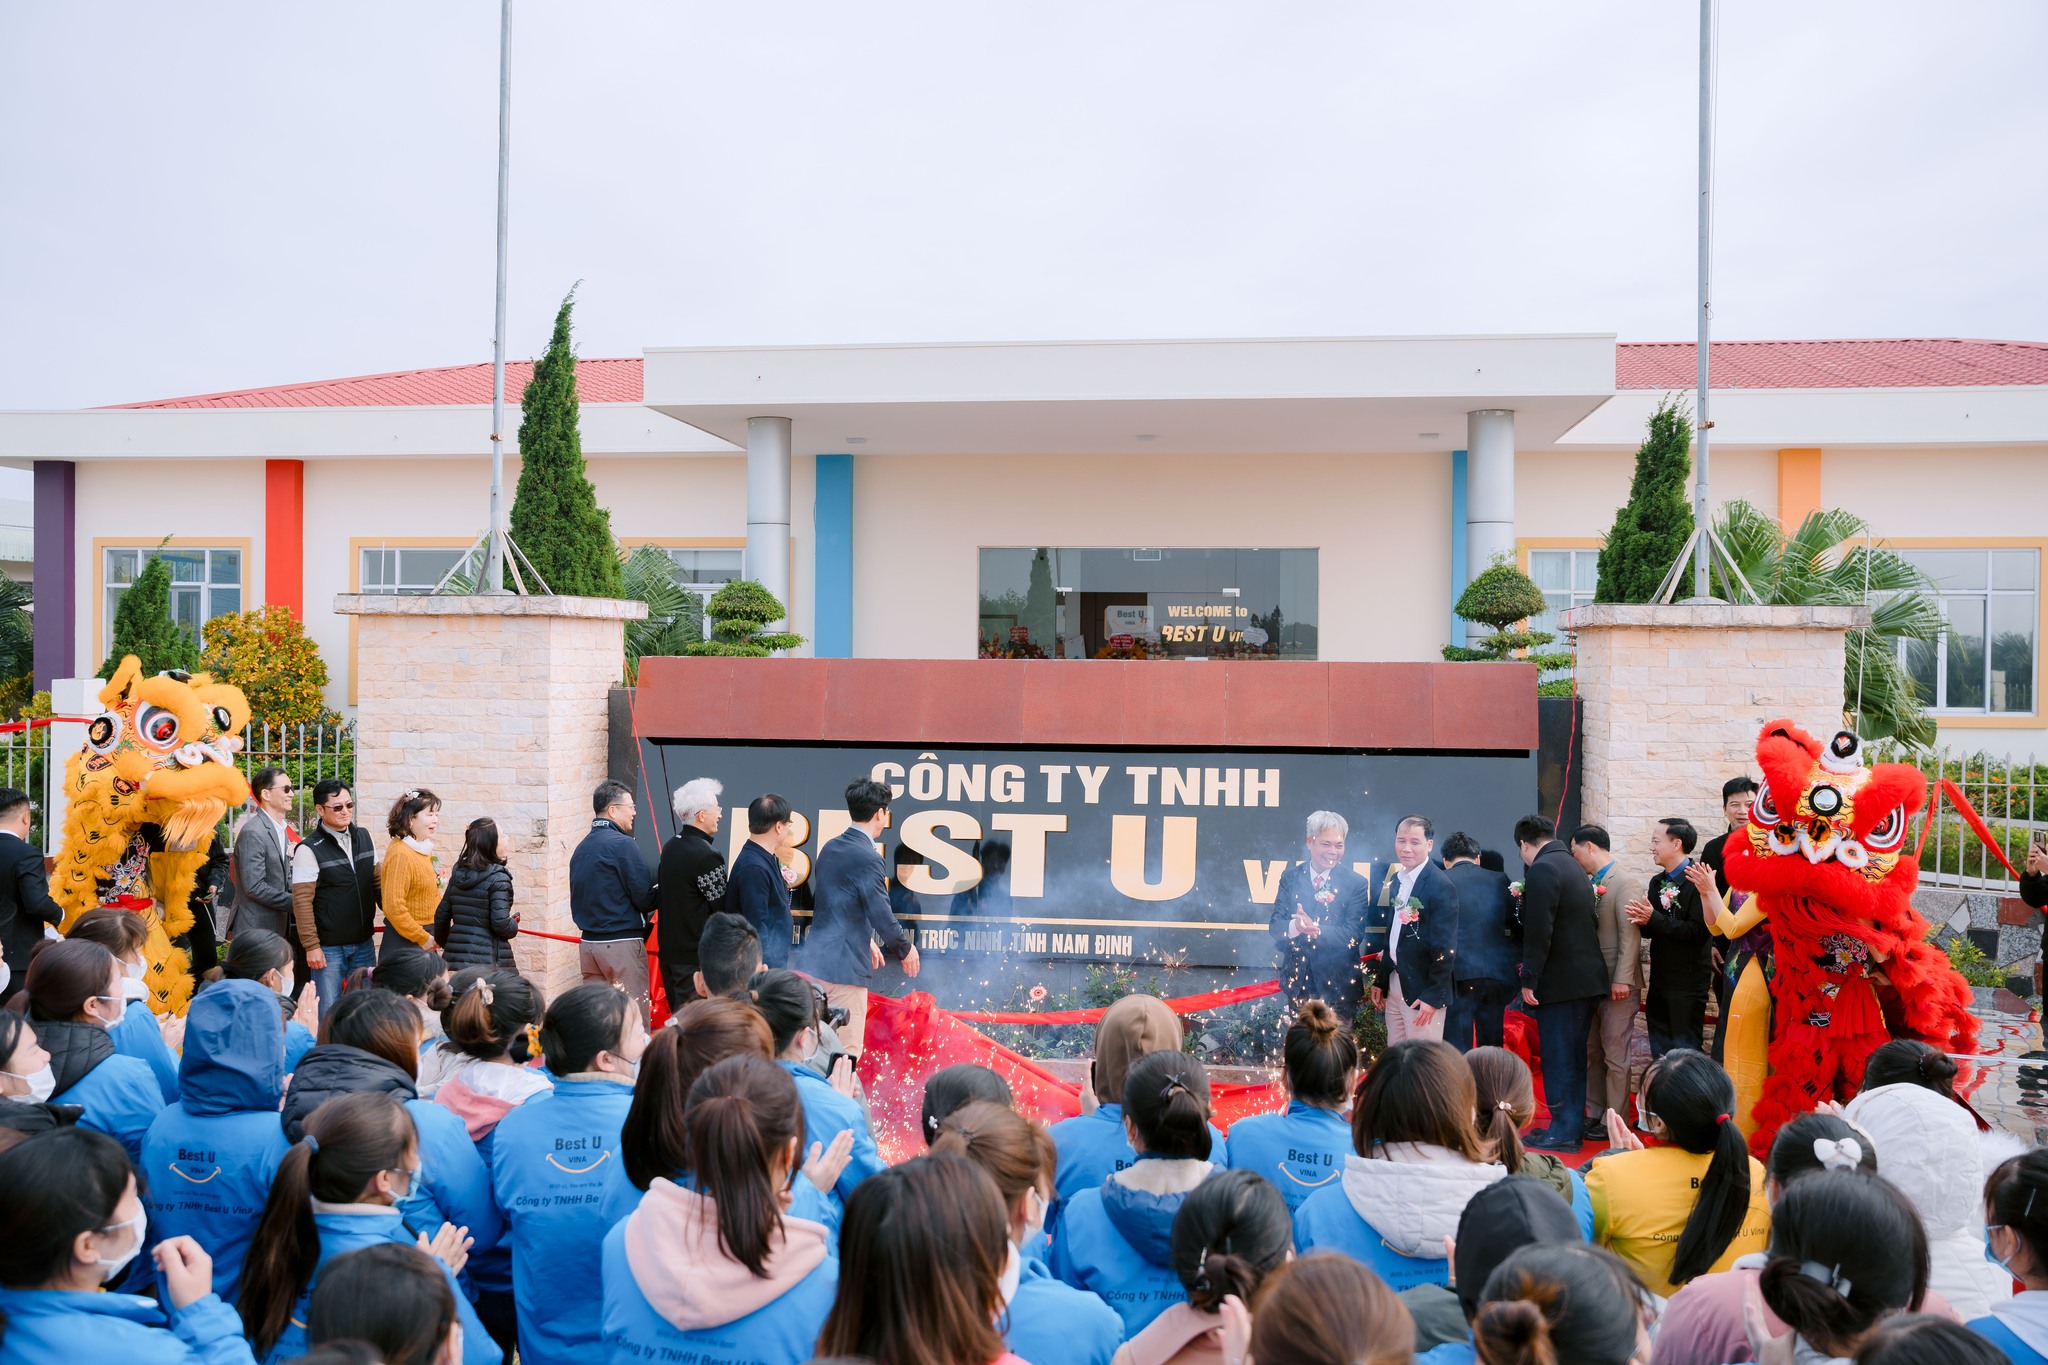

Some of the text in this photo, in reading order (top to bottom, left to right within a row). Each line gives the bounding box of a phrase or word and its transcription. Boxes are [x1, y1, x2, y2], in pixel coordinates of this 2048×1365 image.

[1117, 610, 1136, 618] Best
[1168, 605, 1248, 617] WELCOME to
[1162, 625, 1208, 642] BEST
[1212, 625, 1226, 642] U
[871, 752, 1281, 807] CÔNG TY TNHH
[1110, 814, 1198, 901] U
[920, 927, 960, 954] TRỰC
[1012, 925, 1047, 953] TỈNH
[1052, 932, 1090, 954] NAM
[1095, 934, 1133, 959] ĐỊNH
[555, 1136, 602, 1150] Best U
[178, 1148, 216, 1163] Best U
[1287, 1148, 1333, 1167] Best U
[1115, 1159, 1133, 1172] Be
[1299, 1168, 1317, 1178] VINA
[516, 1194, 599, 1207] Công ty TNHH Be
[166, 1203, 176, 1213] ty
[179, 1201, 203, 1211] TNHH
[204, 1203, 221, 1213] Best
[223, 1206, 230, 1214] U
[1751, 1226, 1765, 1236] Vina
[1139, 1290, 1149, 1301] ty
[1153, 1290, 1185, 1300] TNHH
[660, 1346, 699, 1365] TNHH
